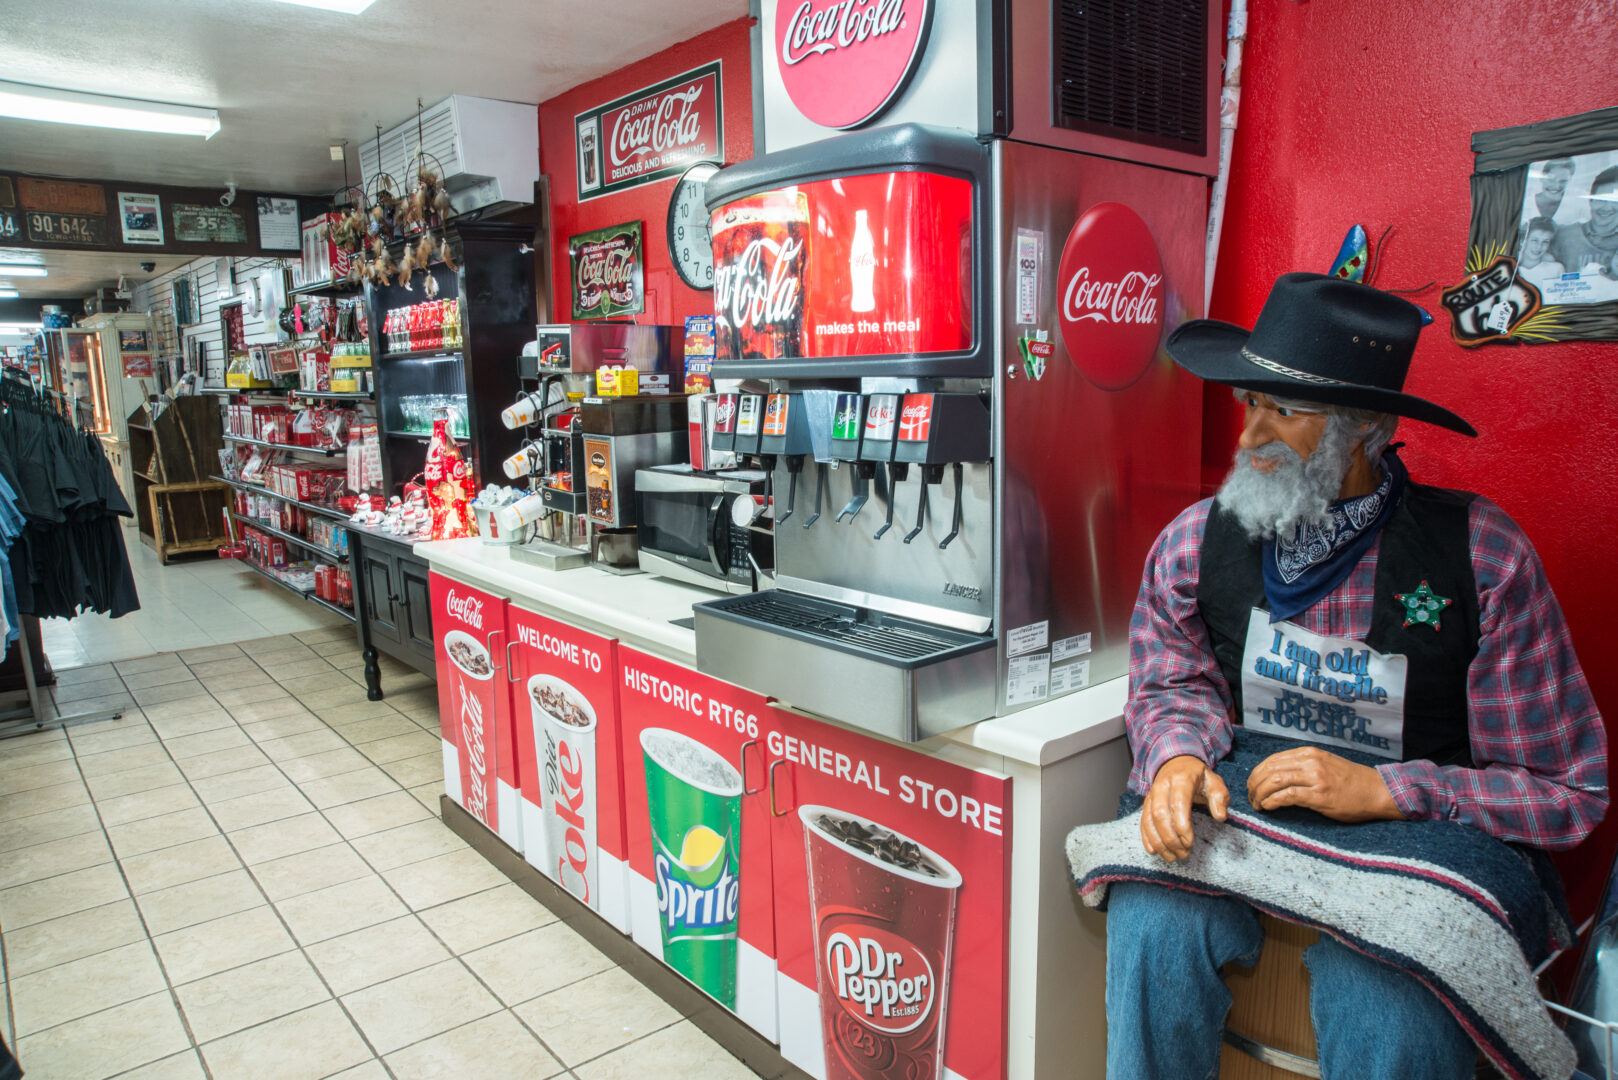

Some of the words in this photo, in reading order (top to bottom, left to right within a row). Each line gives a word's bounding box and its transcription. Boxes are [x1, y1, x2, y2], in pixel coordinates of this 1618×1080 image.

[610, 83, 703, 167] Coca-Cola
[631, 97, 659, 117] DRINK
[612, 163, 643, 180] DELICIOUS
[644, 157, 660, 171] AND
[680, 203, 689, 218] 10
[687, 183, 697, 199] 11
[677, 226, 685, 241] 9
[578, 246, 634, 289] Coca-Cola
[683, 248, 690, 262] 8
[693, 262, 700, 277] 7
[705, 266, 713, 281] 6
[1063, 266, 1163, 325] Coca-Cola
[1450, 269, 1508, 308] ROUTE
[815, 321, 855, 336] makes
[857, 319, 880, 334] the
[883, 317, 921, 333] meal
[446, 588, 484, 630] Coca-Cola
[517, 623, 580, 666] WELCOME
[582, 649, 602, 673] TO
[1270, 628, 1284, 656] I
[1284, 640, 1321, 670] am
[1325, 647, 1371, 677] old
[1254, 655, 1300, 686] and
[1302, 667, 1389, 705] fragile
[624, 665, 704, 717] HISTORIC
[708, 698, 759, 739] RT66
[544, 728, 560, 795] Diet
[767, 730, 890, 796] GENERAL
[898, 774, 1004, 837] STORE
[554, 739, 590, 904] Coke
[655, 852, 739, 928] Sprite
[826, 931, 929, 1018] Pepper
[858, 937, 904, 979] Dr
[852, 1025, 876, 1057] 23
